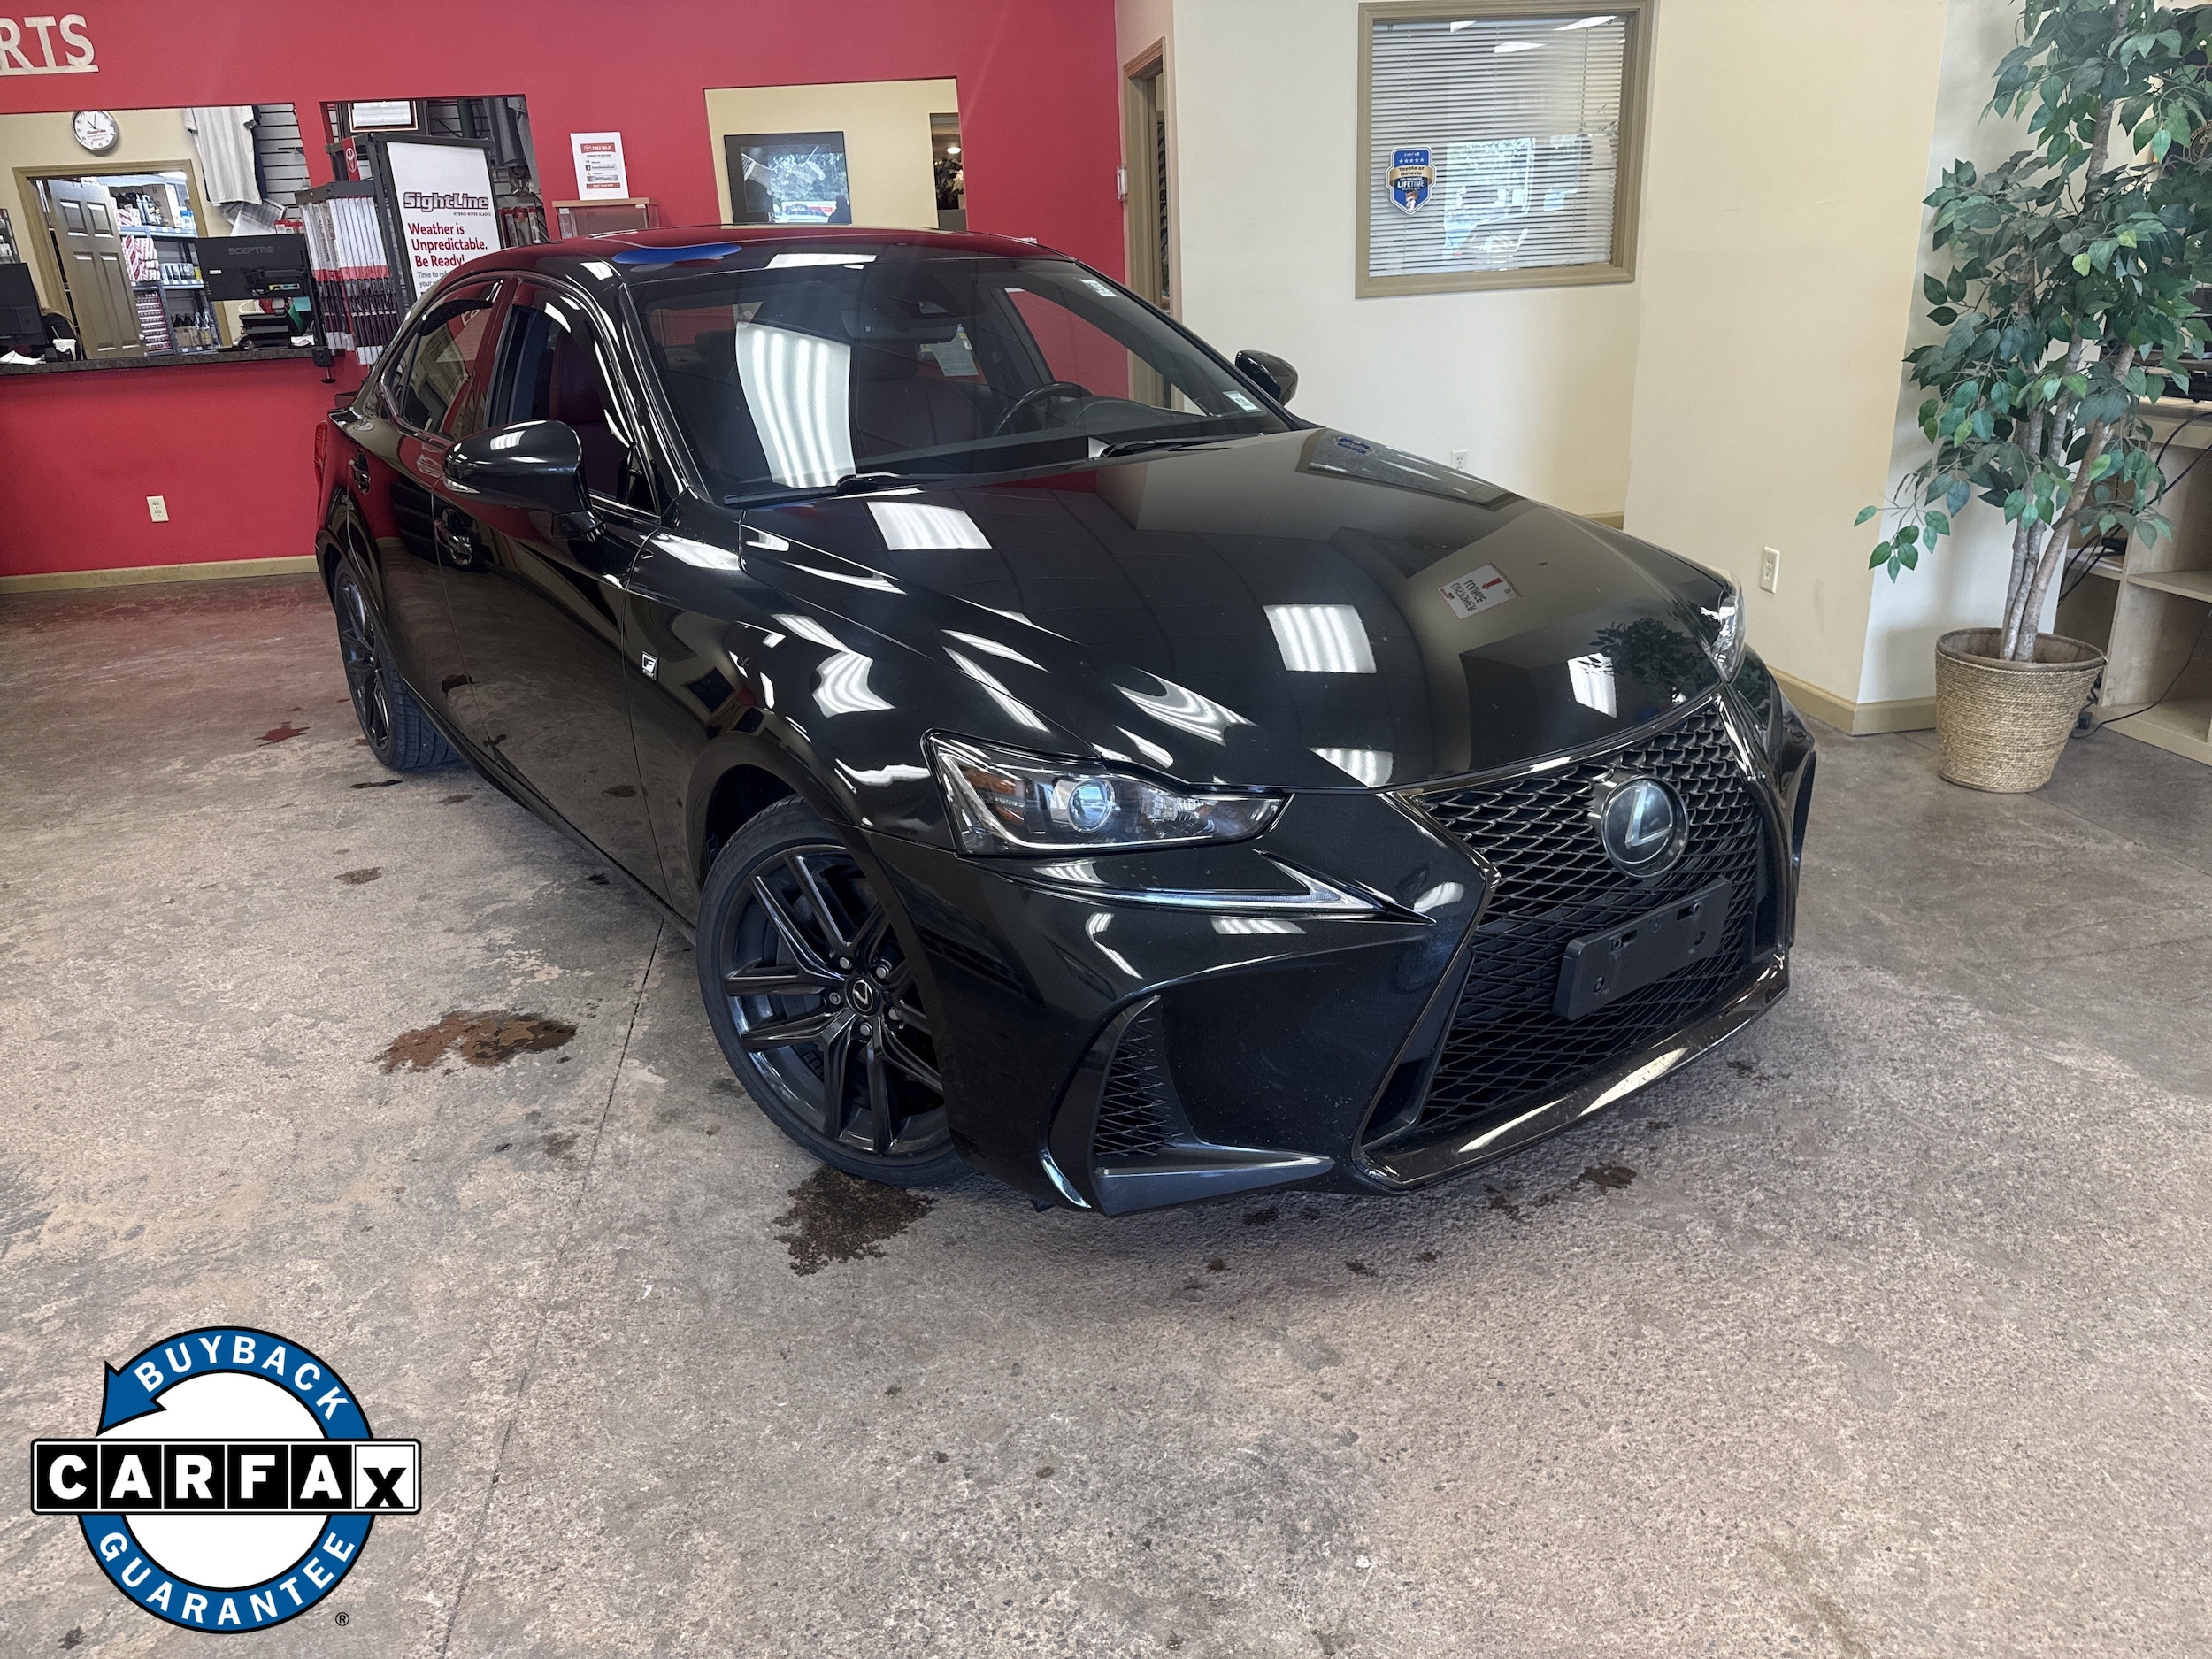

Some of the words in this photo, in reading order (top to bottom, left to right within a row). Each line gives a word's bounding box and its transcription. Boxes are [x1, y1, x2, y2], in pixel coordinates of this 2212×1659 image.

[403, 191, 489, 212] SightLine
[408, 222, 454, 235] Weather
[456, 222, 465, 234] is
[227, 246, 274, 255] SCEPTRE
[411, 238, 488, 254] Unpredictable.
[414, 255, 429, 267] Be
[419, 280, 432, 289] your
